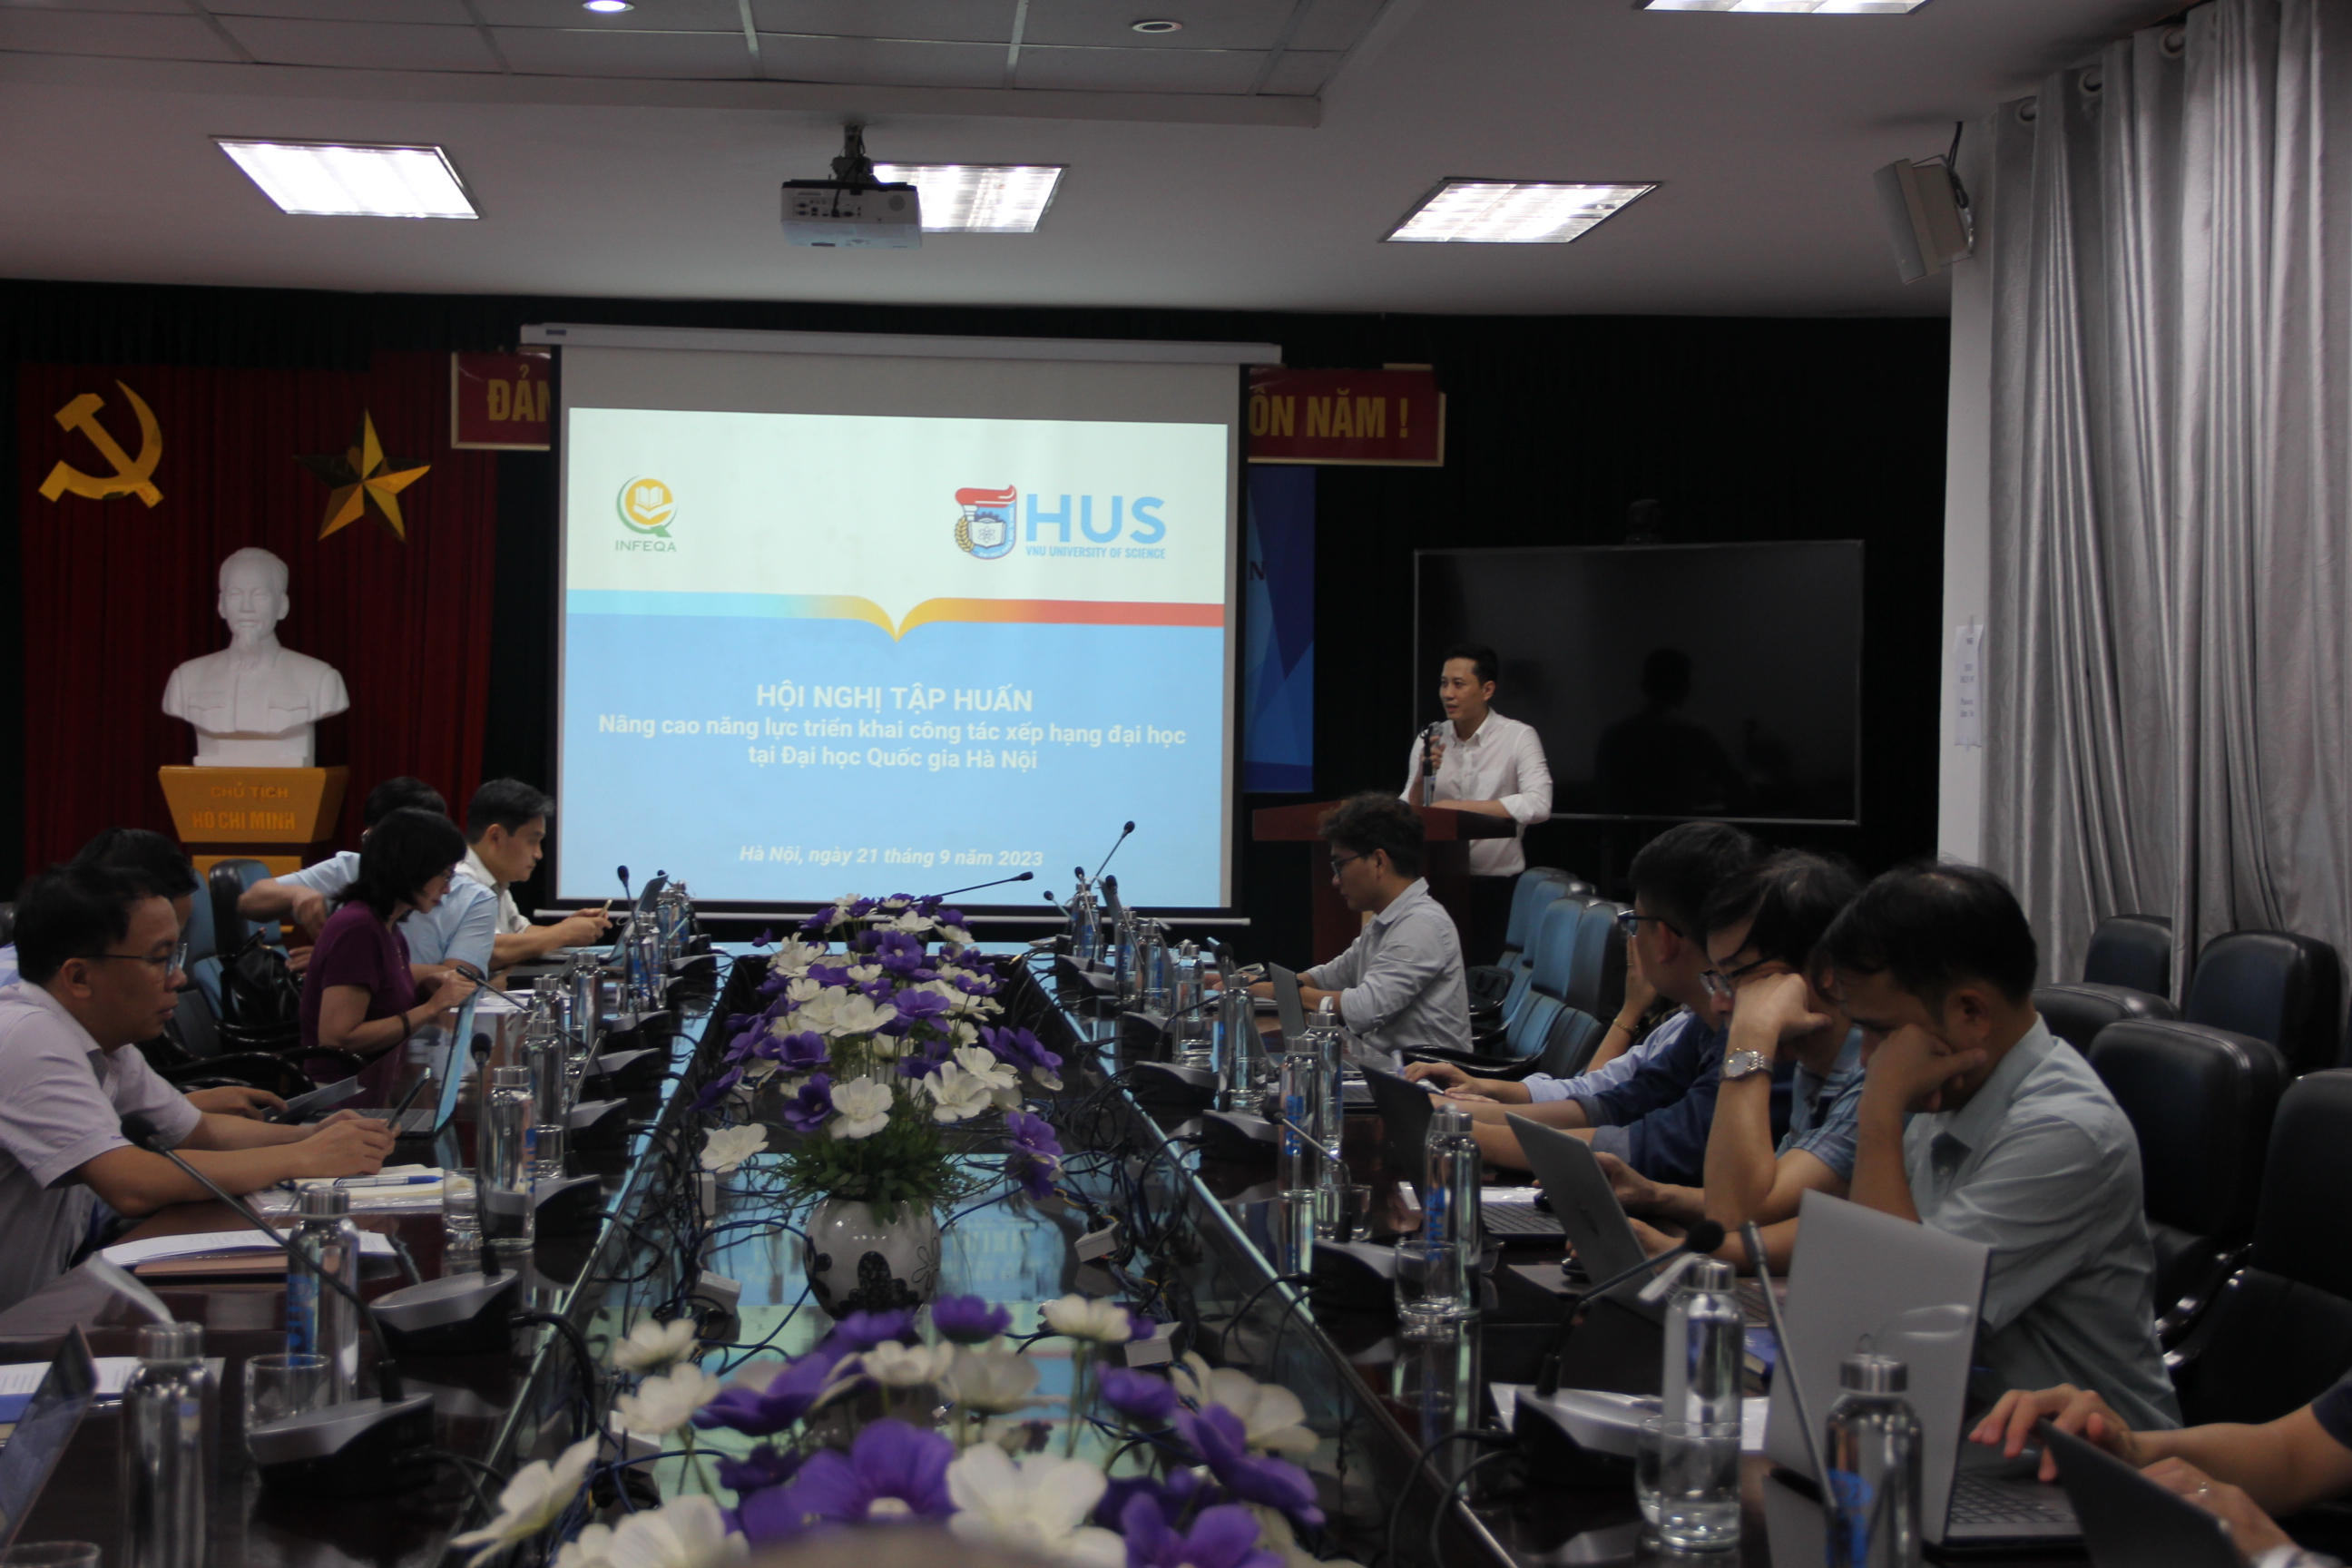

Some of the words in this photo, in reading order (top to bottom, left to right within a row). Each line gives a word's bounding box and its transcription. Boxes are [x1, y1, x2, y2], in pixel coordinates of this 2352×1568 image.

[486, 364, 551, 422] ĐẢN
[1249, 386, 1296, 436] ÔN
[1306, 387, 1387, 437] NĂM
[1025, 494, 1167, 544] HUS
[615, 540, 677, 553] INFEQA
[1025, 545, 1046, 556] VNU
[1049, 546, 1107, 558] UNIVERSITY
[1110, 547, 1122, 558] OF
[1124, 547, 1166, 559] SCIENCE
[757, 680, 805, 712] HỘI
[813, 685, 882, 714] NGHỊ
[890, 681, 946, 715] TẬP
[954, 682, 1033, 711] HUẤN
[599, 714, 656, 739] Nâng
[662, 719, 701, 734] cao
[706, 716, 760, 740] năng
[765, 717, 799, 740] lực
[804, 717, 853, 738] triển
[858, 719, 904, 738] khai
[909, 720, 961, 745] công
[967, 721, 1000, 740] tác
[1005, 721, 1044, 746] xếp
[1049, 722, 1102, 748] hạng
[1108, 724, 1142, 748] đại
[1147, 725, 1186, 749] học
[748, 745, 776, 768] tại
[781, 745, 816, 769] Đại
[822, 746, 861, 769] học
[867, 747, 922, 768] Quốc
[927, 749, 960, 772] gia
[966, 750, 995, 768] Hà
[1001, 750, 1037, 773] Nội
[249, 810, 296, 829] MINH
[740, 844, 765, 861] Hà
[769, 846, 804, 866] Nội,
[808, 846, 853, 867] ngày
[857, 848, 878, 863] 21
[884, 848, 935, 867] tháng
[939, 849, 951, 865] 9
[955, 848, 994, 866] năm
[998, 850, 1044, 867] 2023
